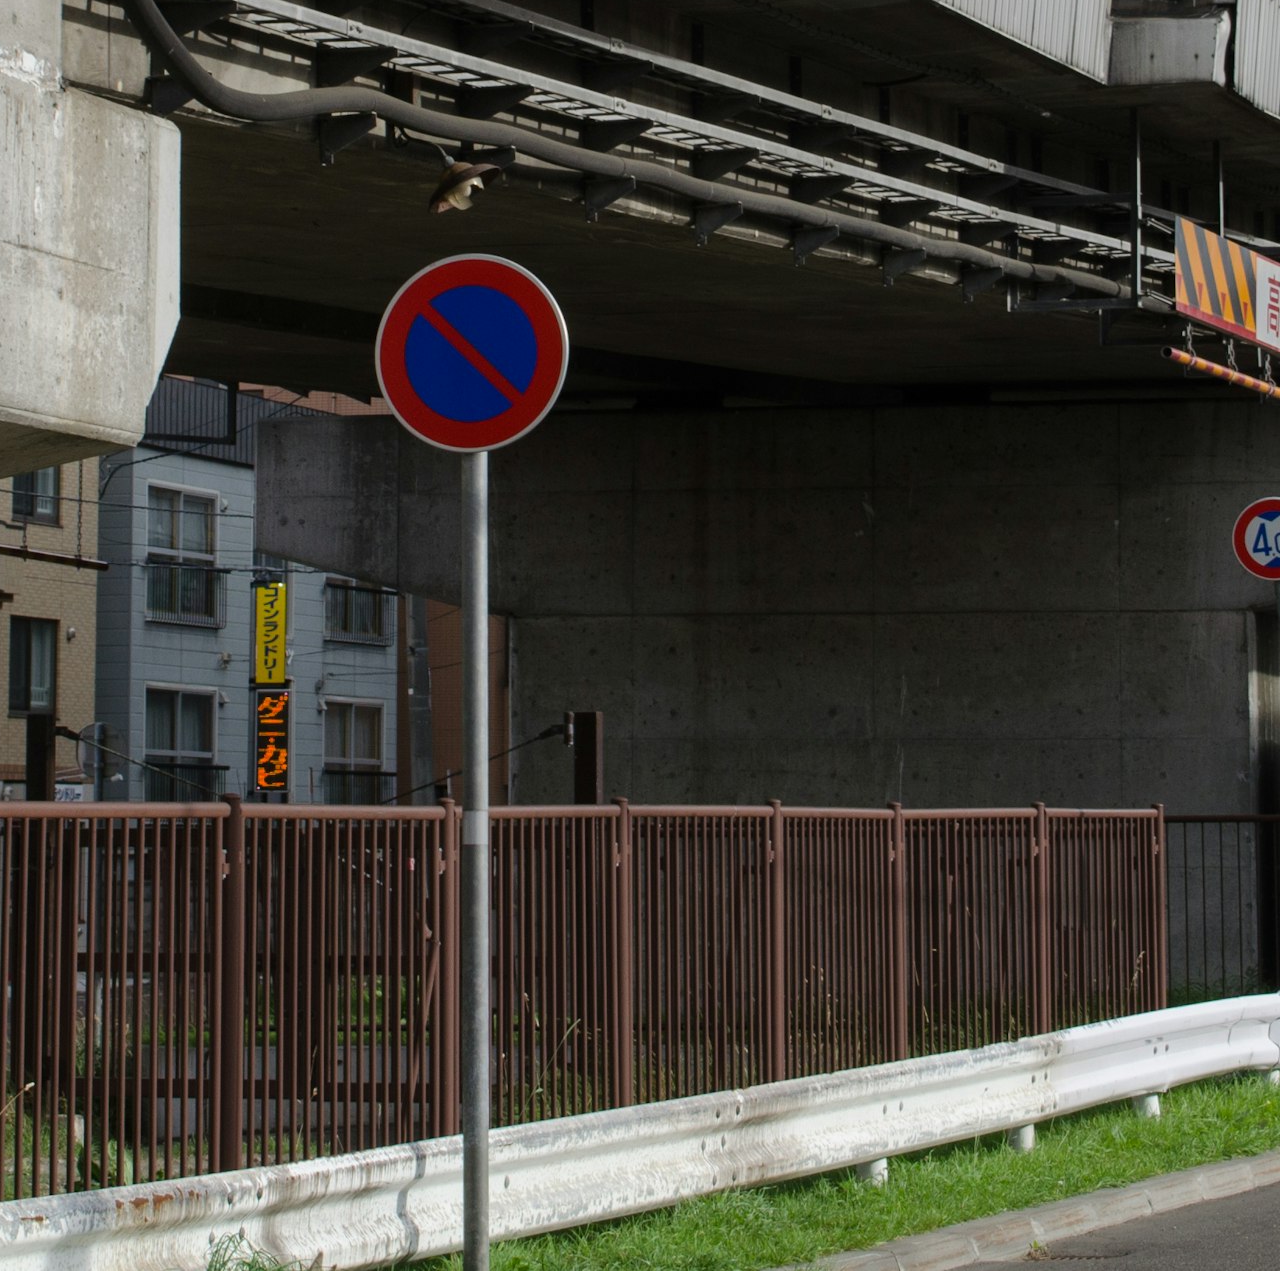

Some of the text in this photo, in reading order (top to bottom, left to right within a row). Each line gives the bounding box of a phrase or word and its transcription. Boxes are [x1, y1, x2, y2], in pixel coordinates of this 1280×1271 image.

[263, 586, 279, 680] コインランドリー
[257, 693, 289, 788] ダニ・カビ
